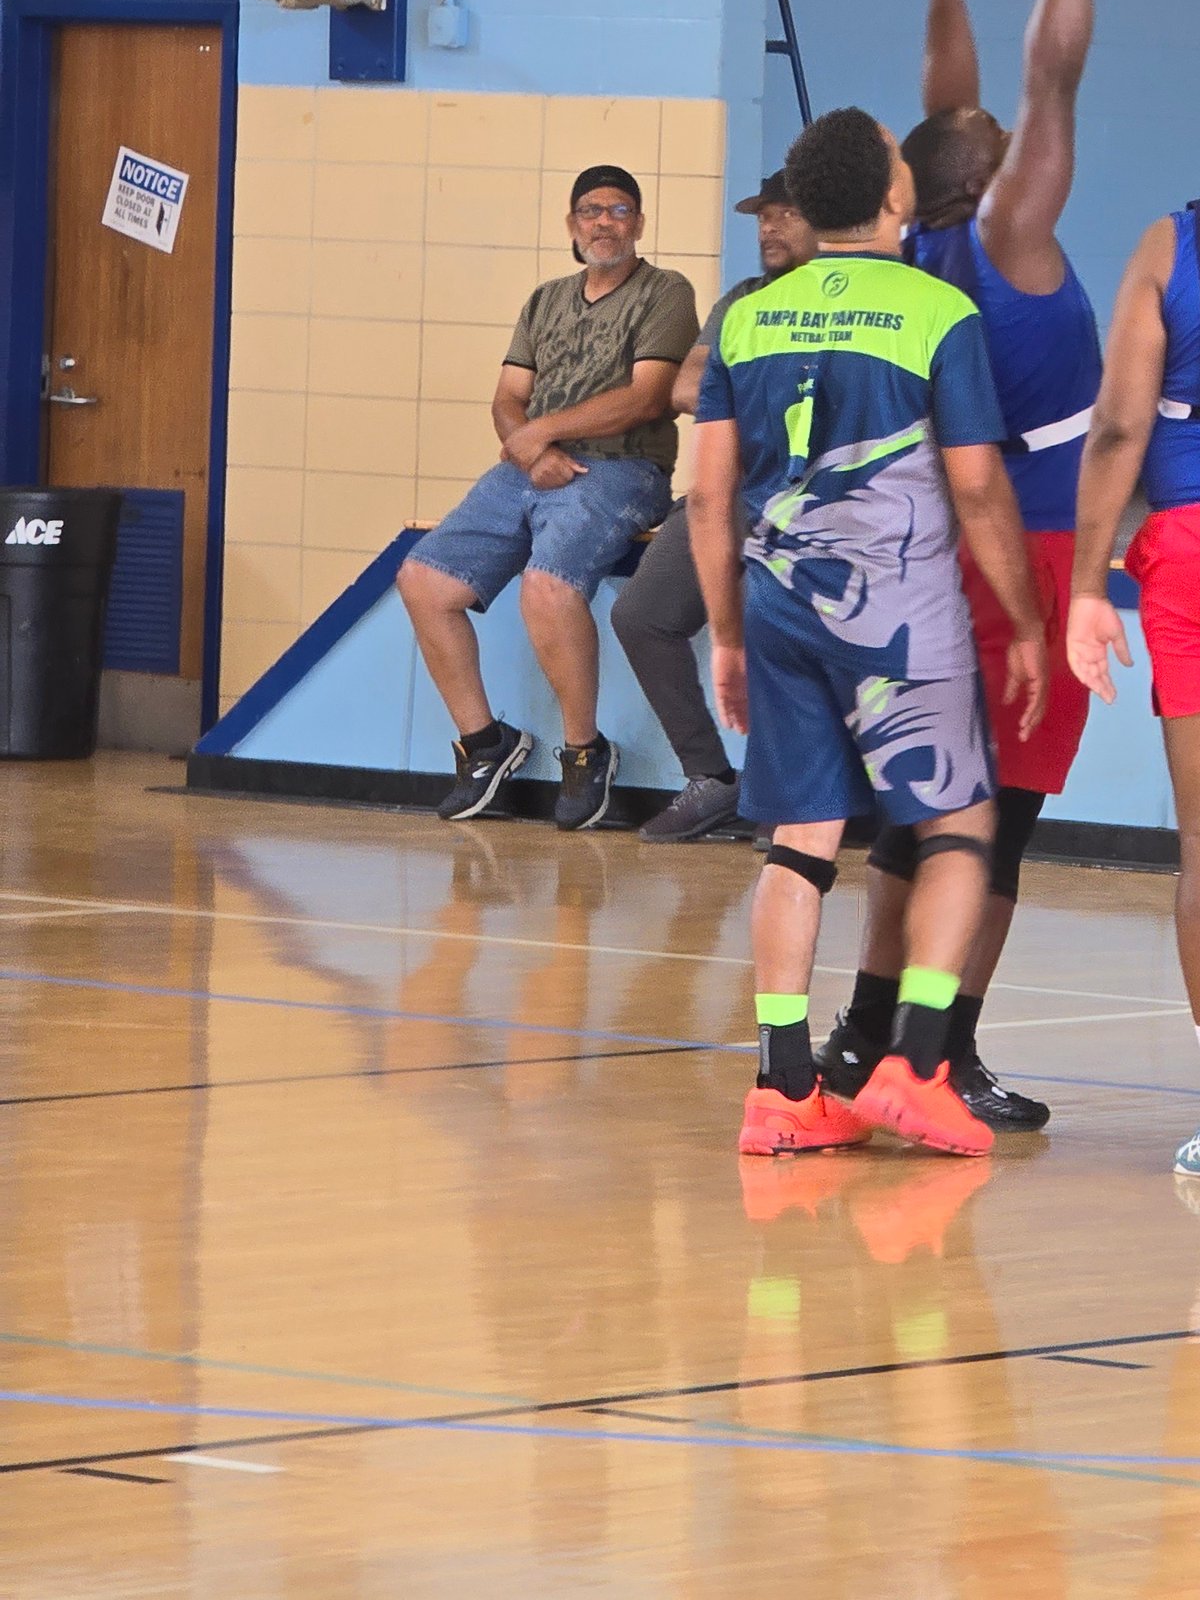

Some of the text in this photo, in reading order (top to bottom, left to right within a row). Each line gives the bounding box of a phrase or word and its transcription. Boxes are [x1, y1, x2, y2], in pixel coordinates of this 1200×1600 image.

[122, 159, 181, 200] NOTICE
[116, 195, 142, 213] CLOSED
[114, 207, 126, 219] ALL
[128, 212, 148, 228] TIMES
[755, 310, 904, 331] TAMPA BAY PANTHERS
[828, 331, 852, 342] TEAM
[5, 516, 64, 545] ACE
